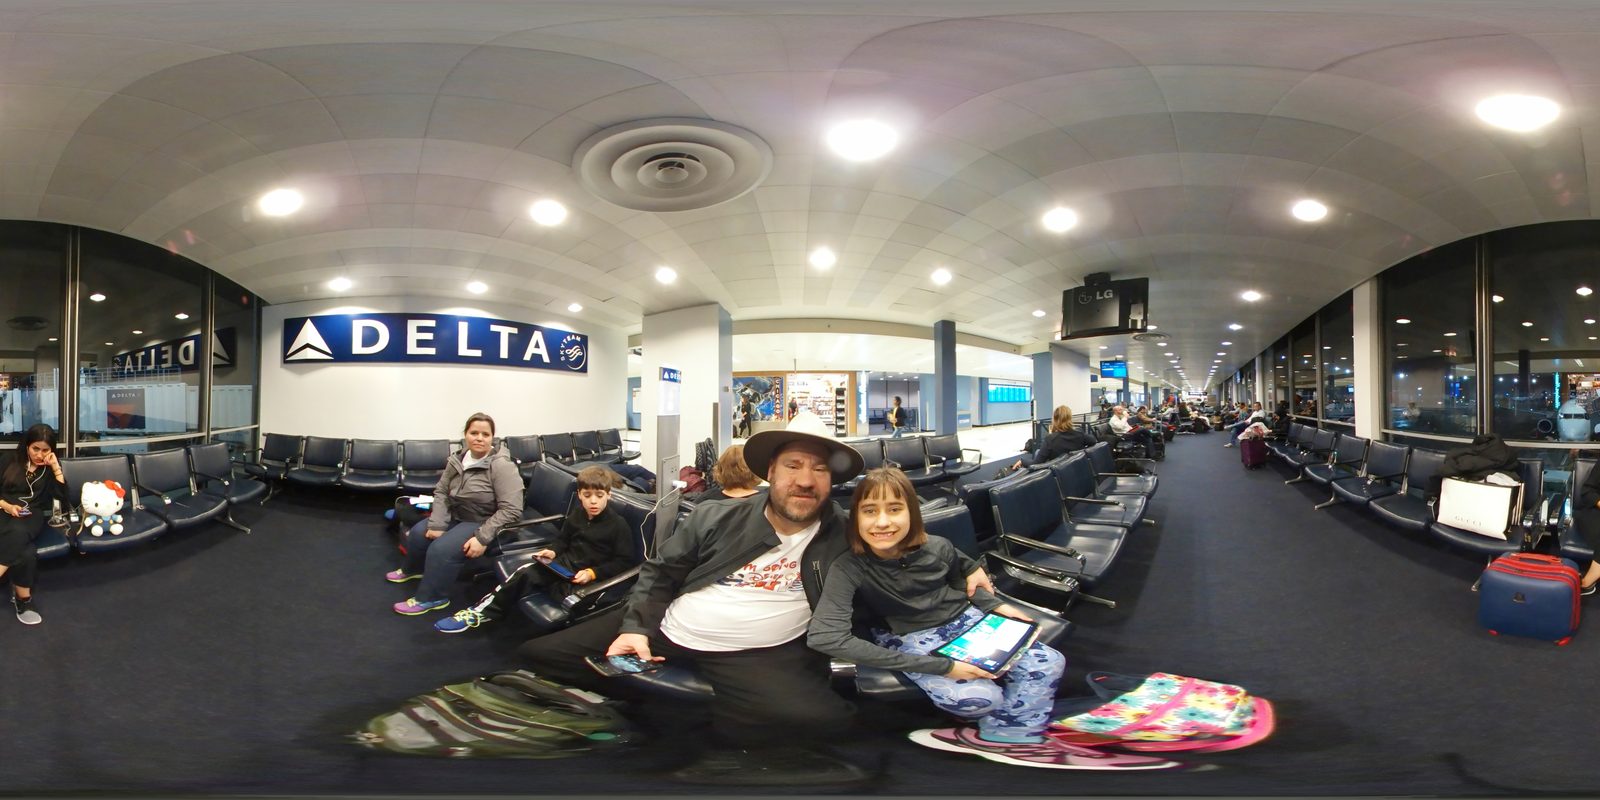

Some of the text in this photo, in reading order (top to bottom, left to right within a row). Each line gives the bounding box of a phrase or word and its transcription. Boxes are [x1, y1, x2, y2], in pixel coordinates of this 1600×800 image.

[1096, 290, 1113, 300] LG
[352, 319, 550, 363] DELTA
[560, 334, 581, 361] SKYTEAM
